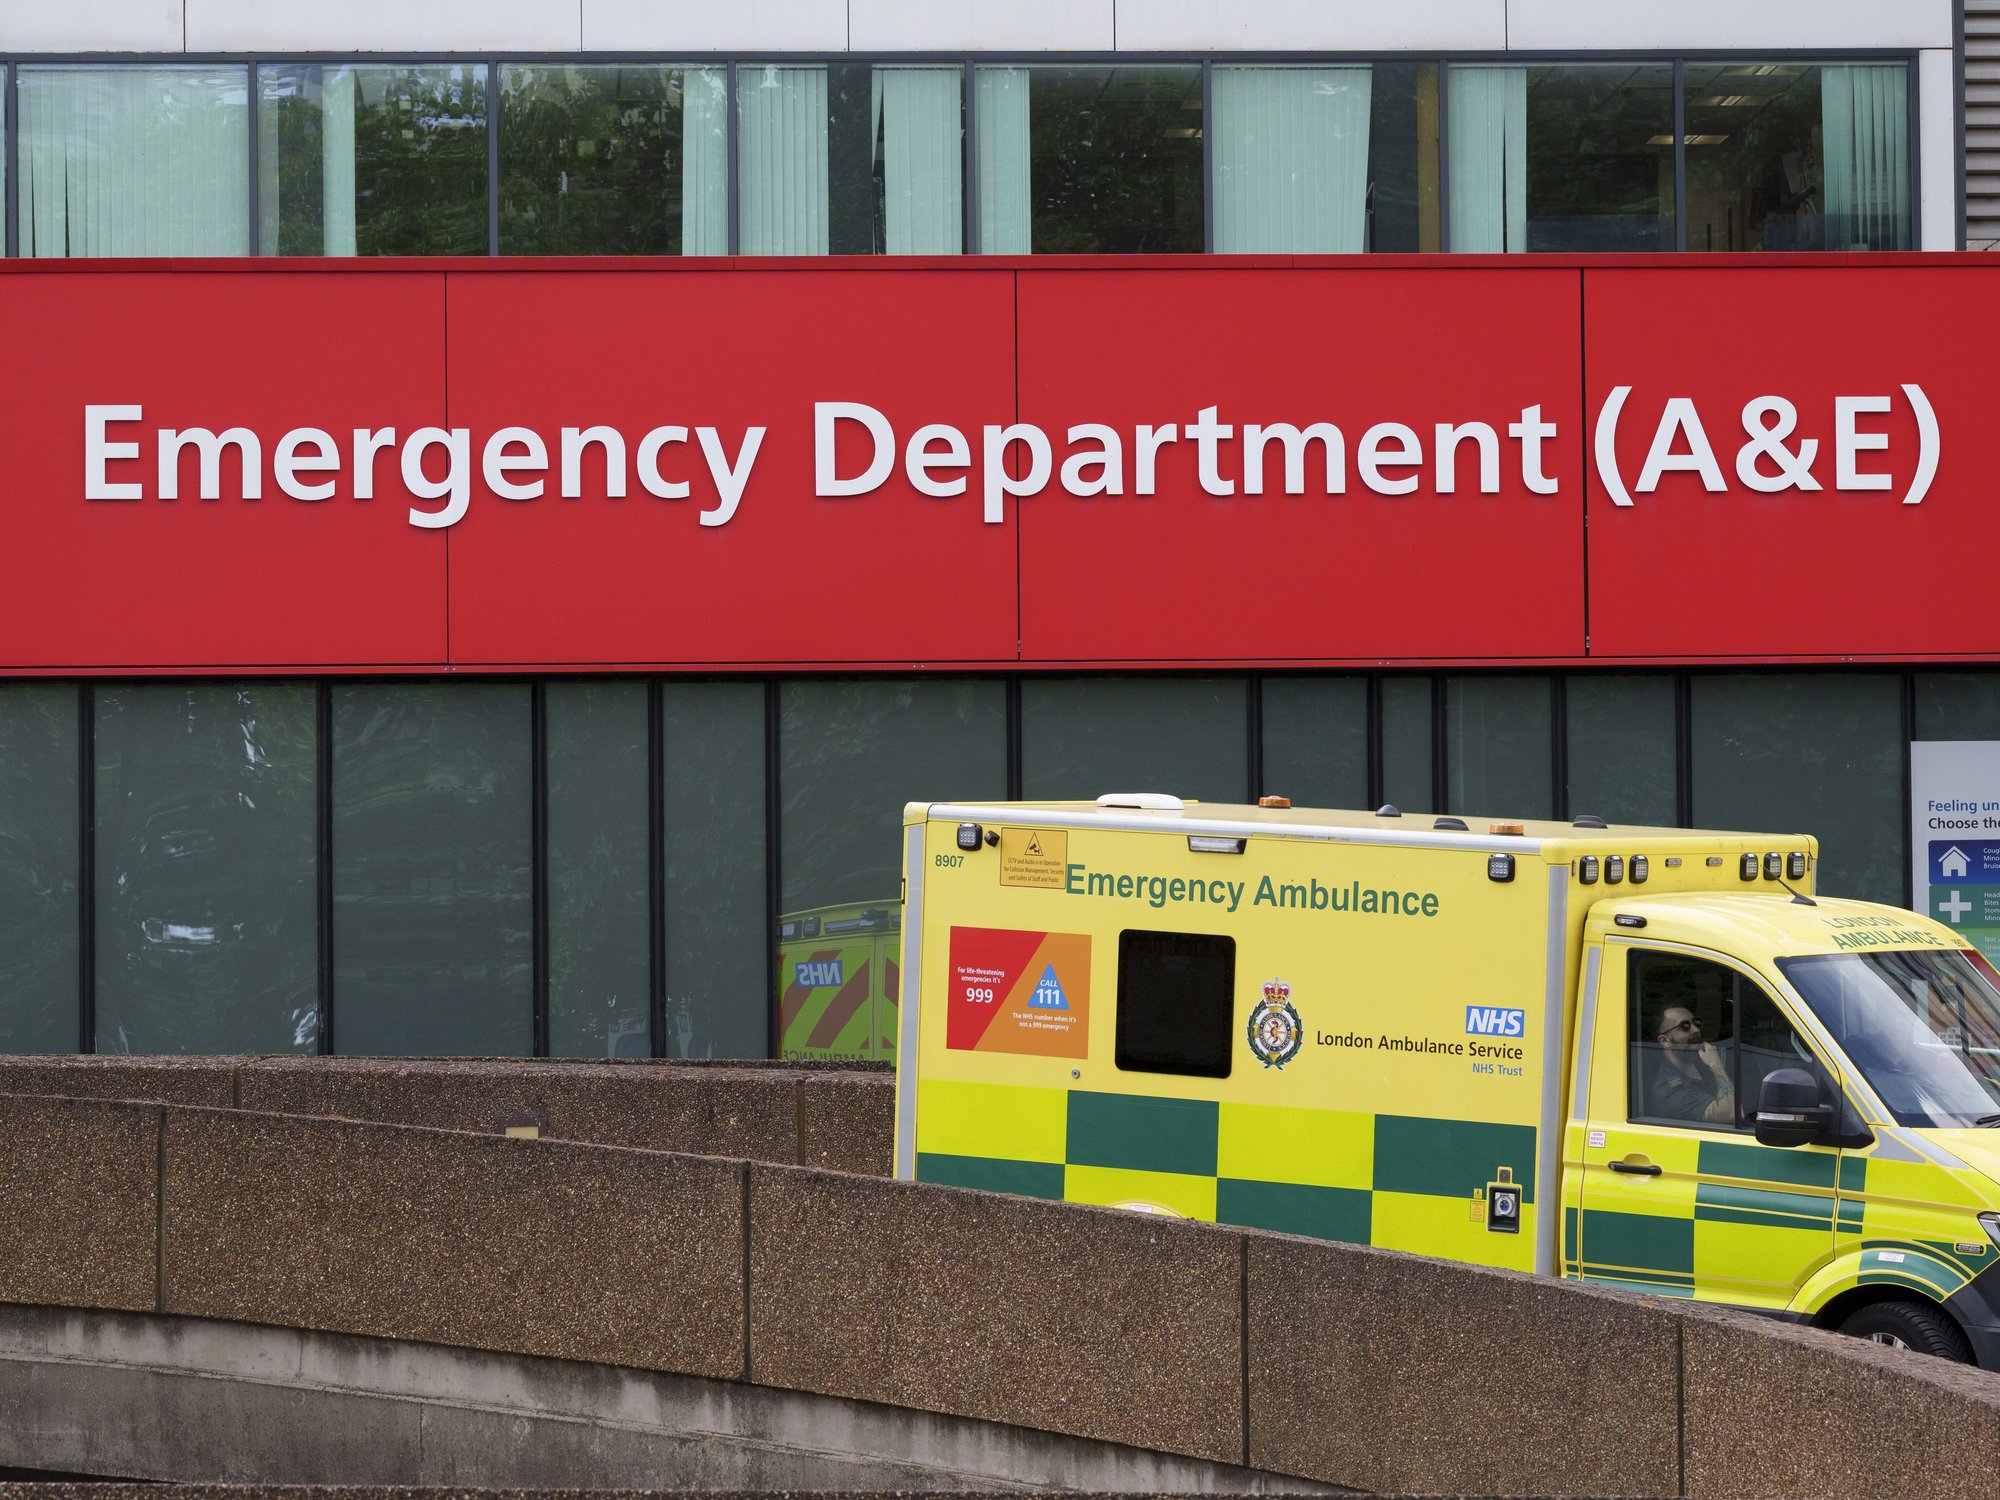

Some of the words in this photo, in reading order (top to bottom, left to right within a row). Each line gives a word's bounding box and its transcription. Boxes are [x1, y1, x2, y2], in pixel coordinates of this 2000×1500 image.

[84, 403, 767, 529] Emergency
[813, 401, 1557, 524] Department
[1594, 384, 1941, 507] (A&E)
[1928, 800, 1977, 814] Feeling
[1983, 801, 2000, 811] un
[1928, 817, 1979, 829] Choose
[1983, 847, 2000, 855] Coug
[935, 855, 964, 867] 8907
[1066, 864, 1245, 912] Emergency
[1253, 876, 1439, 917] Ambulance
[1821, 916, 1904, 929] LONDON
[1830, 930, 1945, 950] AMBULANCE
[966, 967, 1005, 978] life-threatening
[1040, 979, 1058, 987] CALL
[966, 987, 993, 1003] 999
[1036, 988, 1060, 1005] 111
[1042, 1023, 1070, 1031] emergency
[1467, 1008, 1523, 1035] NHS
[1317, 1030, 1373, 1048] London
[1378, 1035, 1464, 1056] Ambulance
[1468, 1041, 1523, 1060] Service
[1472, 1062, 1494, 1074] NHS
[1497, 1064, 1523, 1076] Trust
